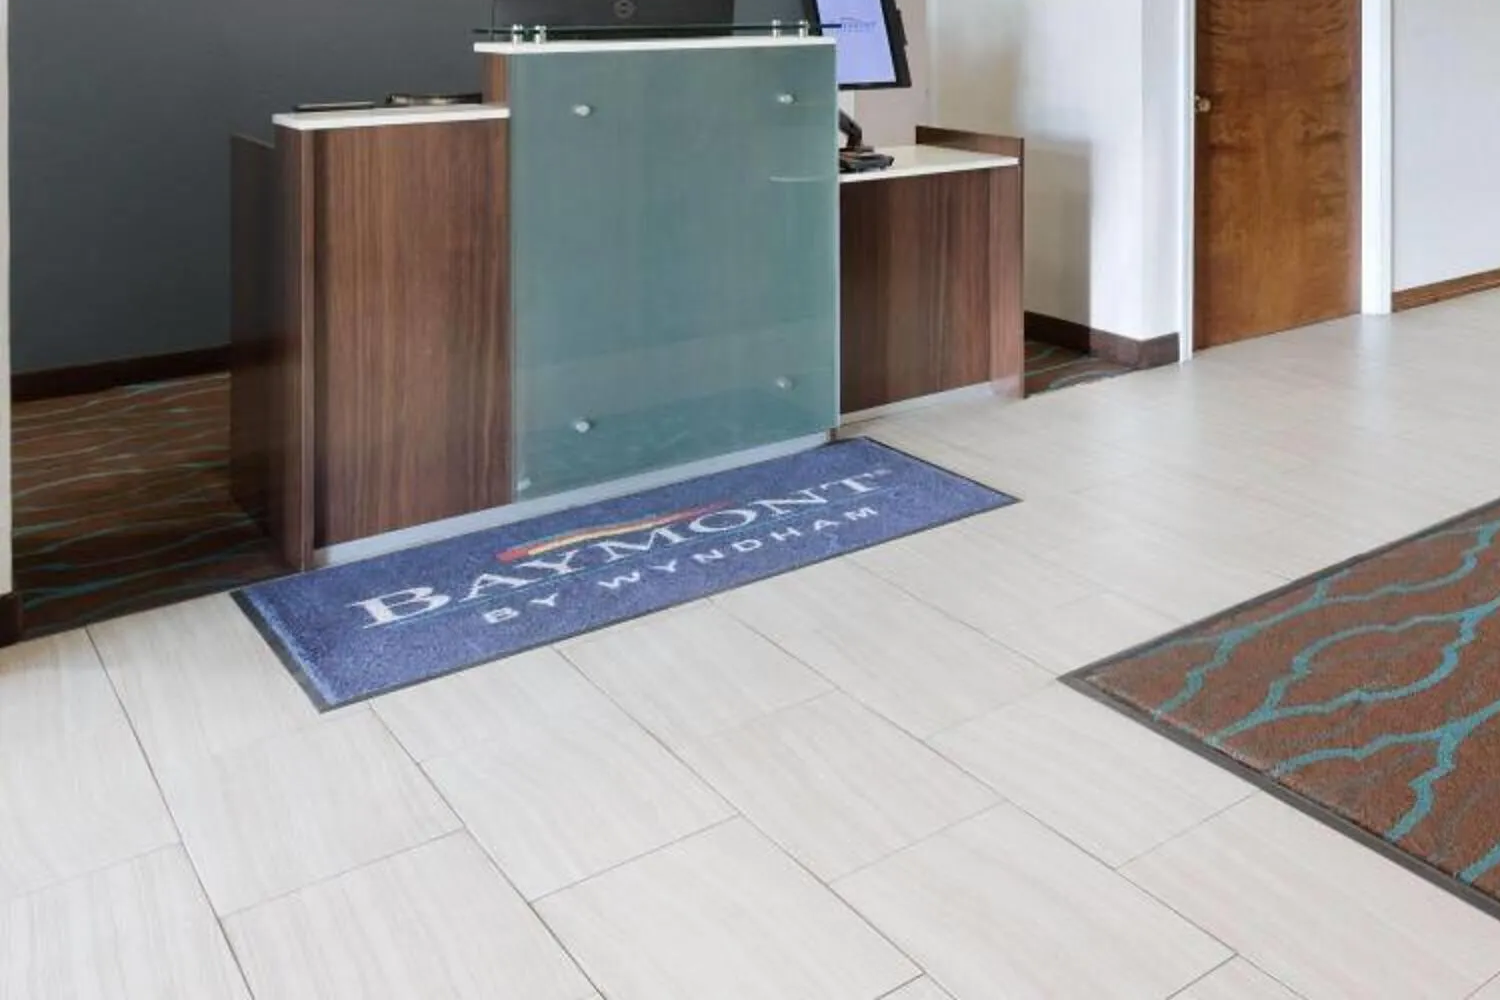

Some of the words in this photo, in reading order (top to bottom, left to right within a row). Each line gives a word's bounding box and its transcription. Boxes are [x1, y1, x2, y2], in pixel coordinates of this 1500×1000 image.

[351, 472, 876, 629] BAYMONT
[482, 593, 561, 625] BY
[597, 505, 878, 590] WYNDHAM
